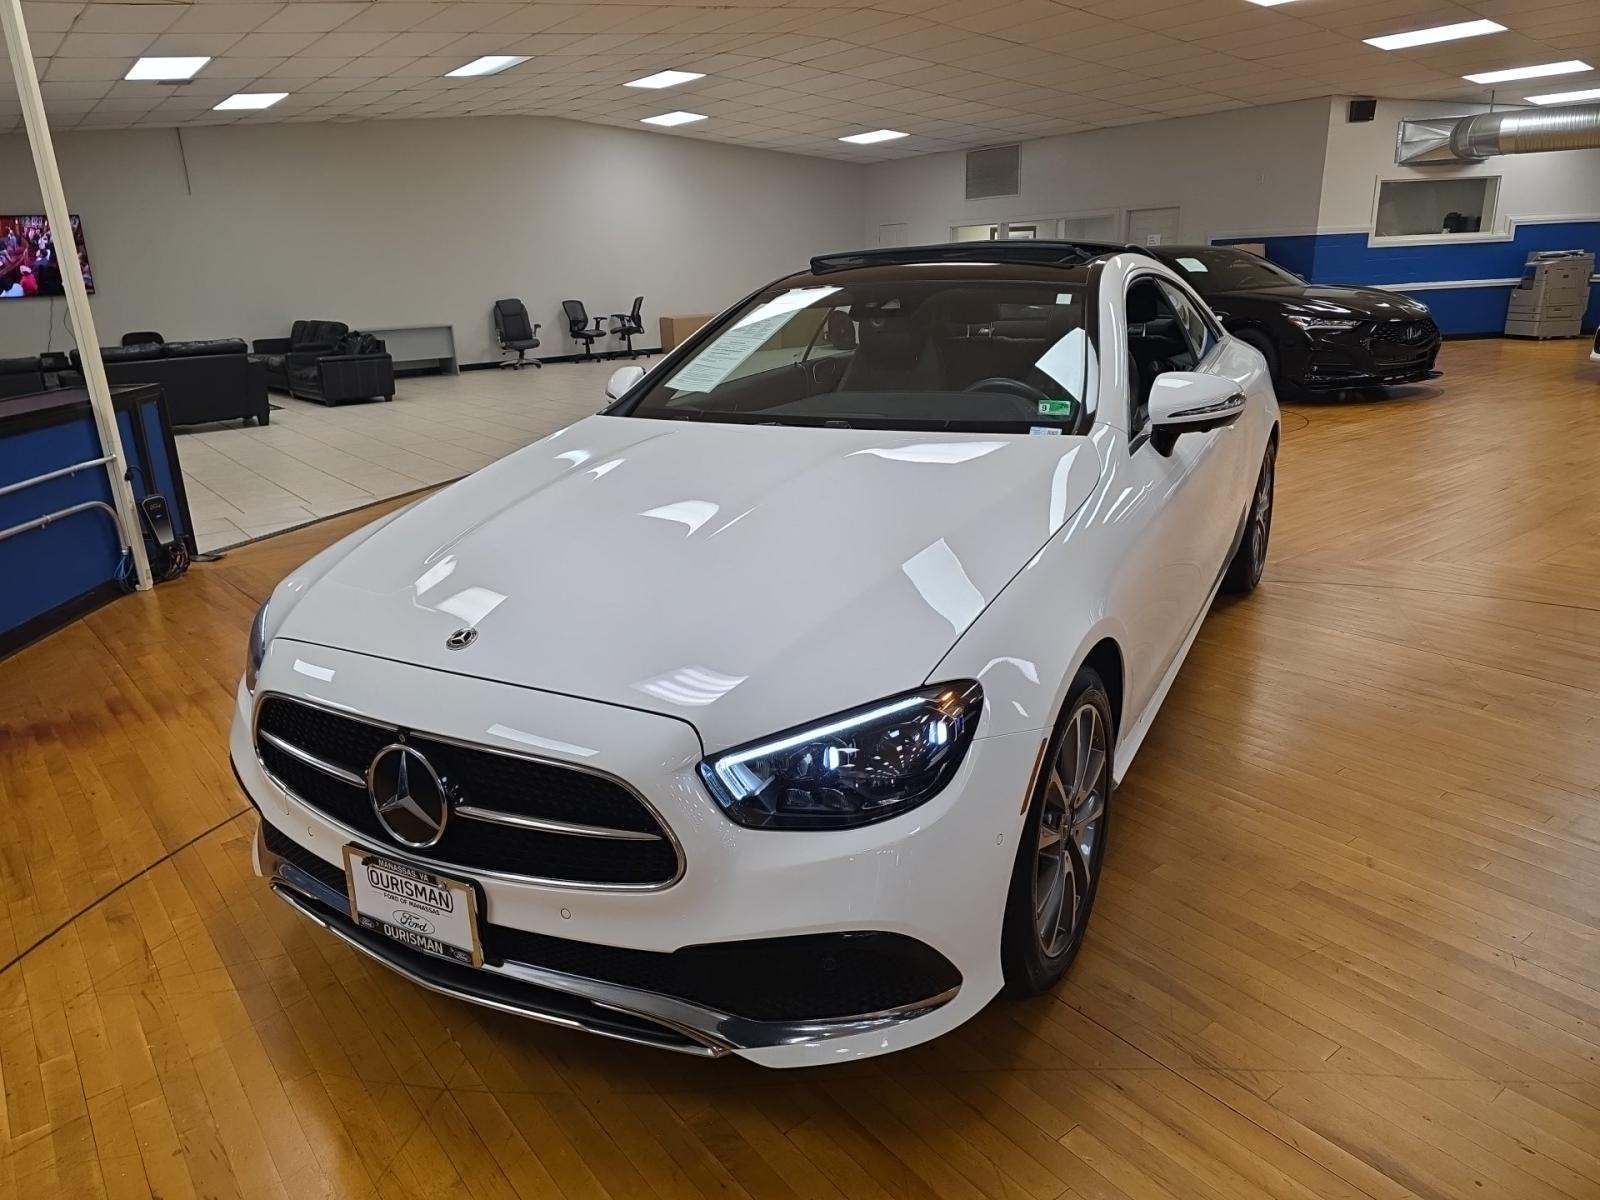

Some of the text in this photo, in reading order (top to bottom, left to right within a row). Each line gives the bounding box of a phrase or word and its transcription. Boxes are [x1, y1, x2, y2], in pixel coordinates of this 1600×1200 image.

[420, 873, 429, 882] VA
[369, 869, 449, 910] OURISMAN
[383, 893, 399, 903] FORD
[409, 901, 440, 916] MANASSAS
[400, 913, 428, 932] Ford
[383, 924, 443, 955] OURISMAN
